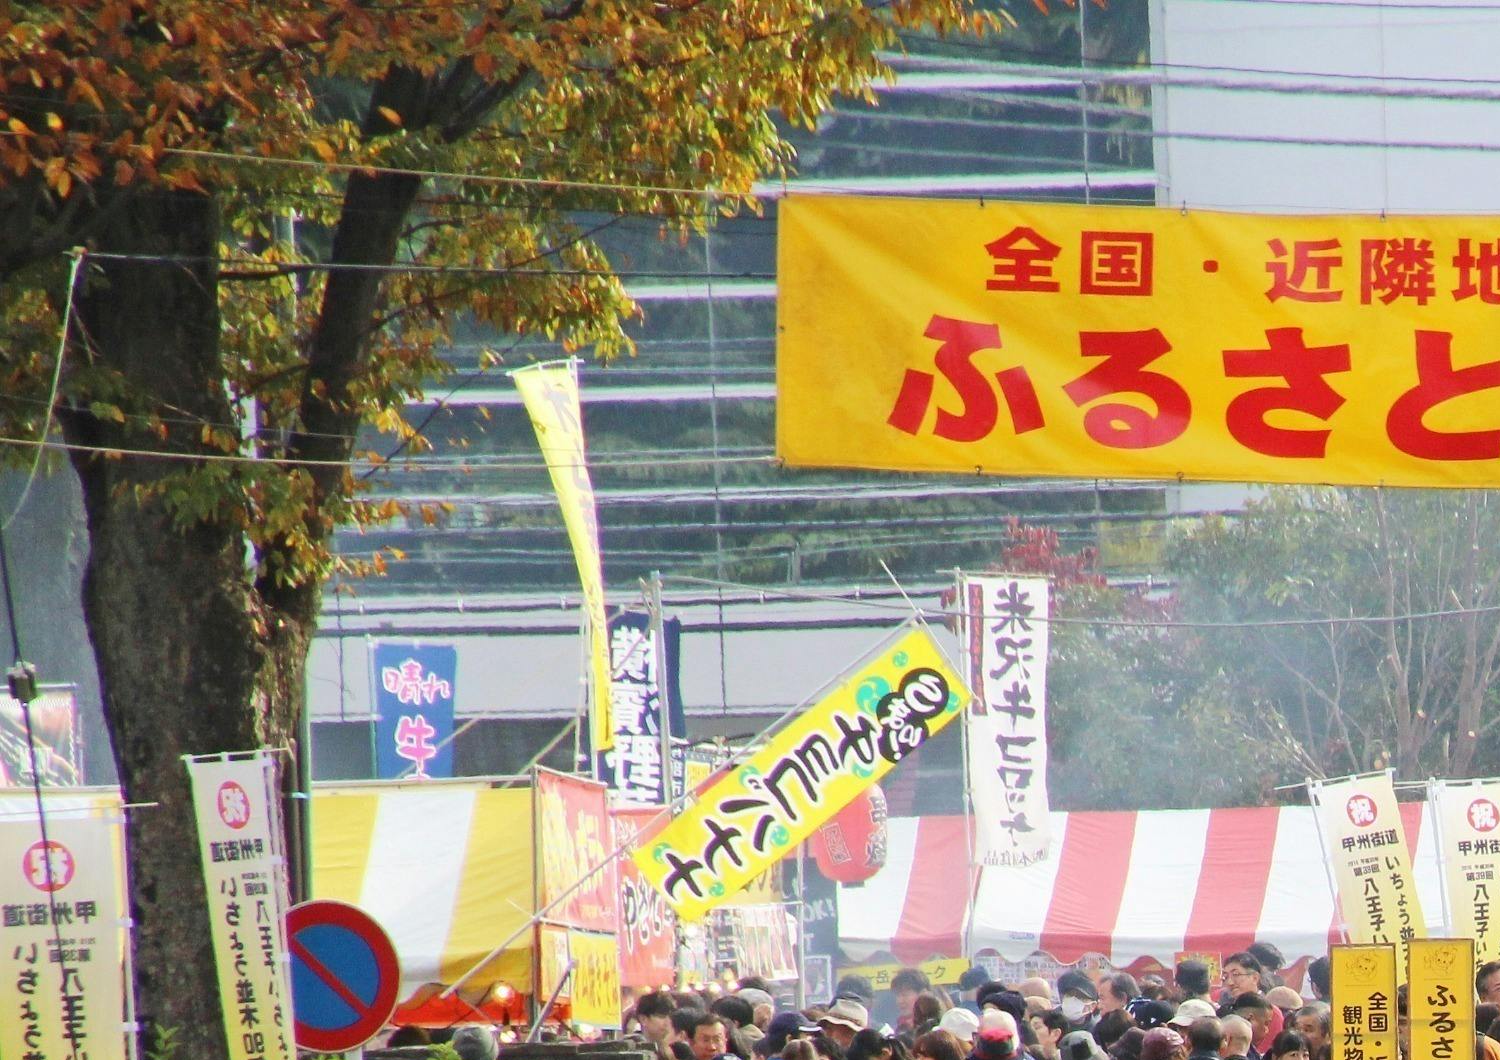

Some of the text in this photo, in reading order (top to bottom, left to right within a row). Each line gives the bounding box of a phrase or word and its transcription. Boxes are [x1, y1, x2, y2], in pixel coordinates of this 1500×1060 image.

[1348, 797, 1376, 825] 祝
[1469, 802, 1498, 830] 祝
[1341, 829, 1399, 852] 甲州街道
[1385, 856, 1413, 955] いちょう並
